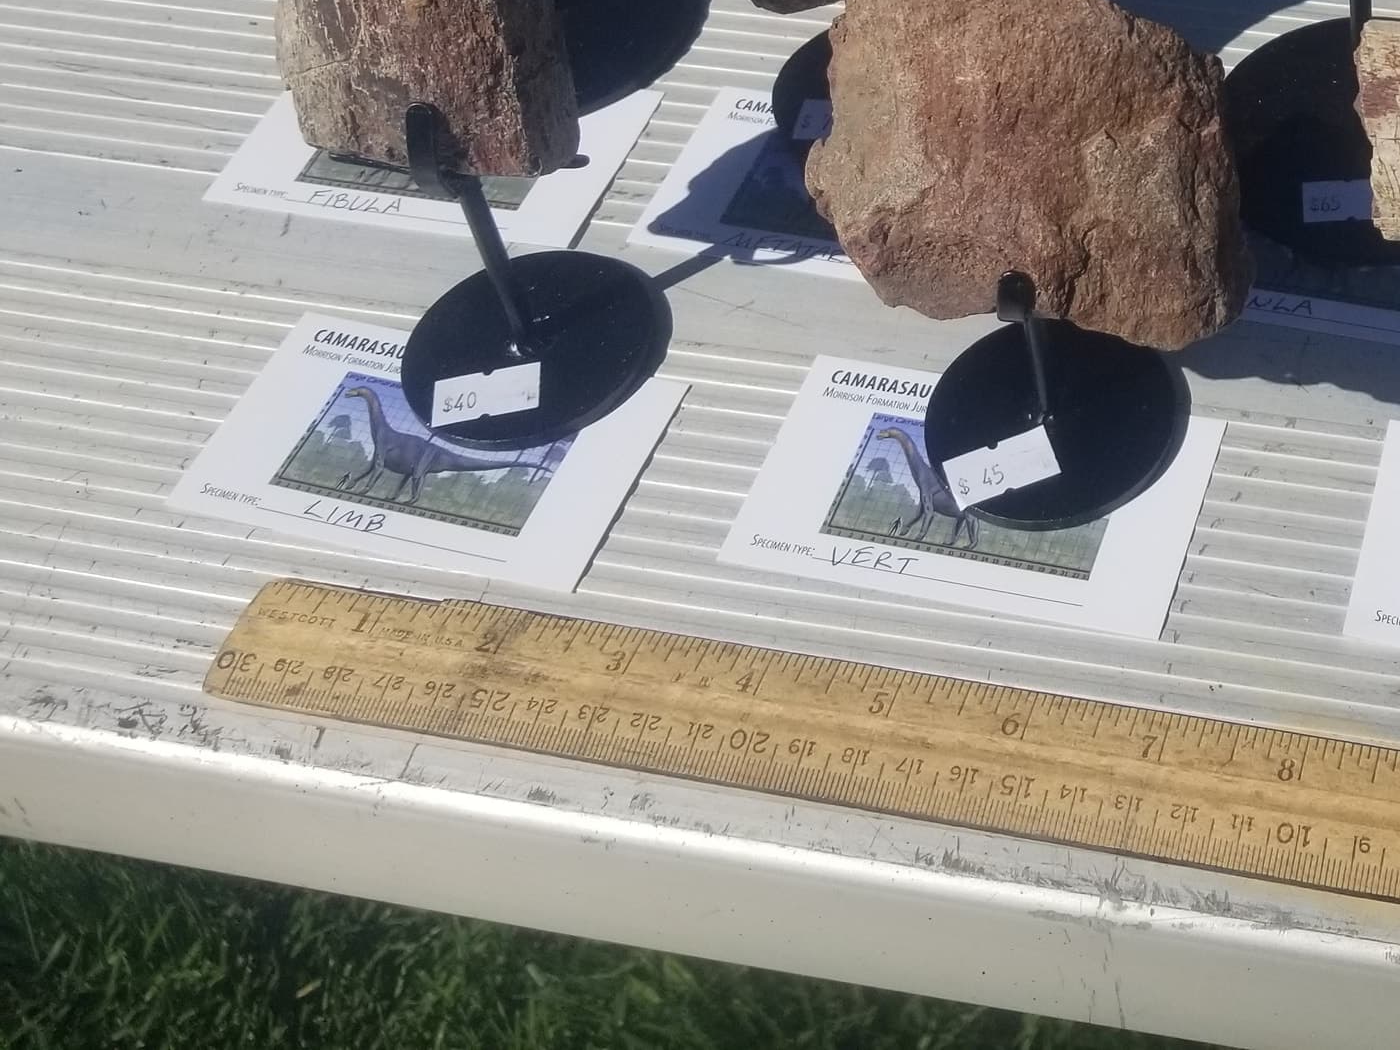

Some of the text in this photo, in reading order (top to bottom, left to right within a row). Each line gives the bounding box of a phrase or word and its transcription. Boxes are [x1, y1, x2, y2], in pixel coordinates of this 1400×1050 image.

[764, 116, 777, 127] FO
[306, 189, 402, 214] FIBULA
[302, 344, 343, 363] MORRISON
[342, 352, 386, 371] FORMATION
[831, 369, 933, 399] CAMARASAU
[442, 391, 477, 414] $40
[822, 386, 864, 404] MORRISON
[866, 393, 911, 412] FORMATION
[982, 463, 1006, 486] 45
[200, 482, 239, 501] SPECIMEN
[303, 499, 387, 532] LIMB
[750, 533, 816, 558] SPECIMEN TYPE:
[831, 545, 921, 575] VERT
[257, 606, 337, 629] WESTCOTT
[217, 652, 258, 673] 30
[273, 658, 305, 675] 29
[323, 666, 354, 683] 28
[373, 675, 405, 691] 27
[351, 609, 372, 633] 1
[475, 630, 498, 652] 2
[605, 650, 627, 672] 3
[735, 672, 755, 693] 4
[868, 691, 890, 715] 5
[1001, 712, 1021, 736] 6
[1276, 758, 1295, 782] 8
[425, 680, 456, 698] 26
[470, 688, 512, 712] 25
[526, 698, 558, 714] 24
[577, 704, 610, 723] 23
[630, 712, 662, 731] 22
[687, 721, 715, 740] 21
[729, 729, 771, 753] 20
[788, 739, 817, 757] 19
[841, 747, 870, 766] 18
[896, 757, 925, 774] 17
[950, 765, 980, 784] 16
[999, 774, 1036, 798] 15
[1060, 784, 1088, 800] 14
[1114, 793, 1144, 812] 13
[1170, 803, 1199, 823] 12
[1231, 814, 1255, 832] 11
[1276, 822, 1312, 848] 10
[1359, 836, 1372, 854] 9
